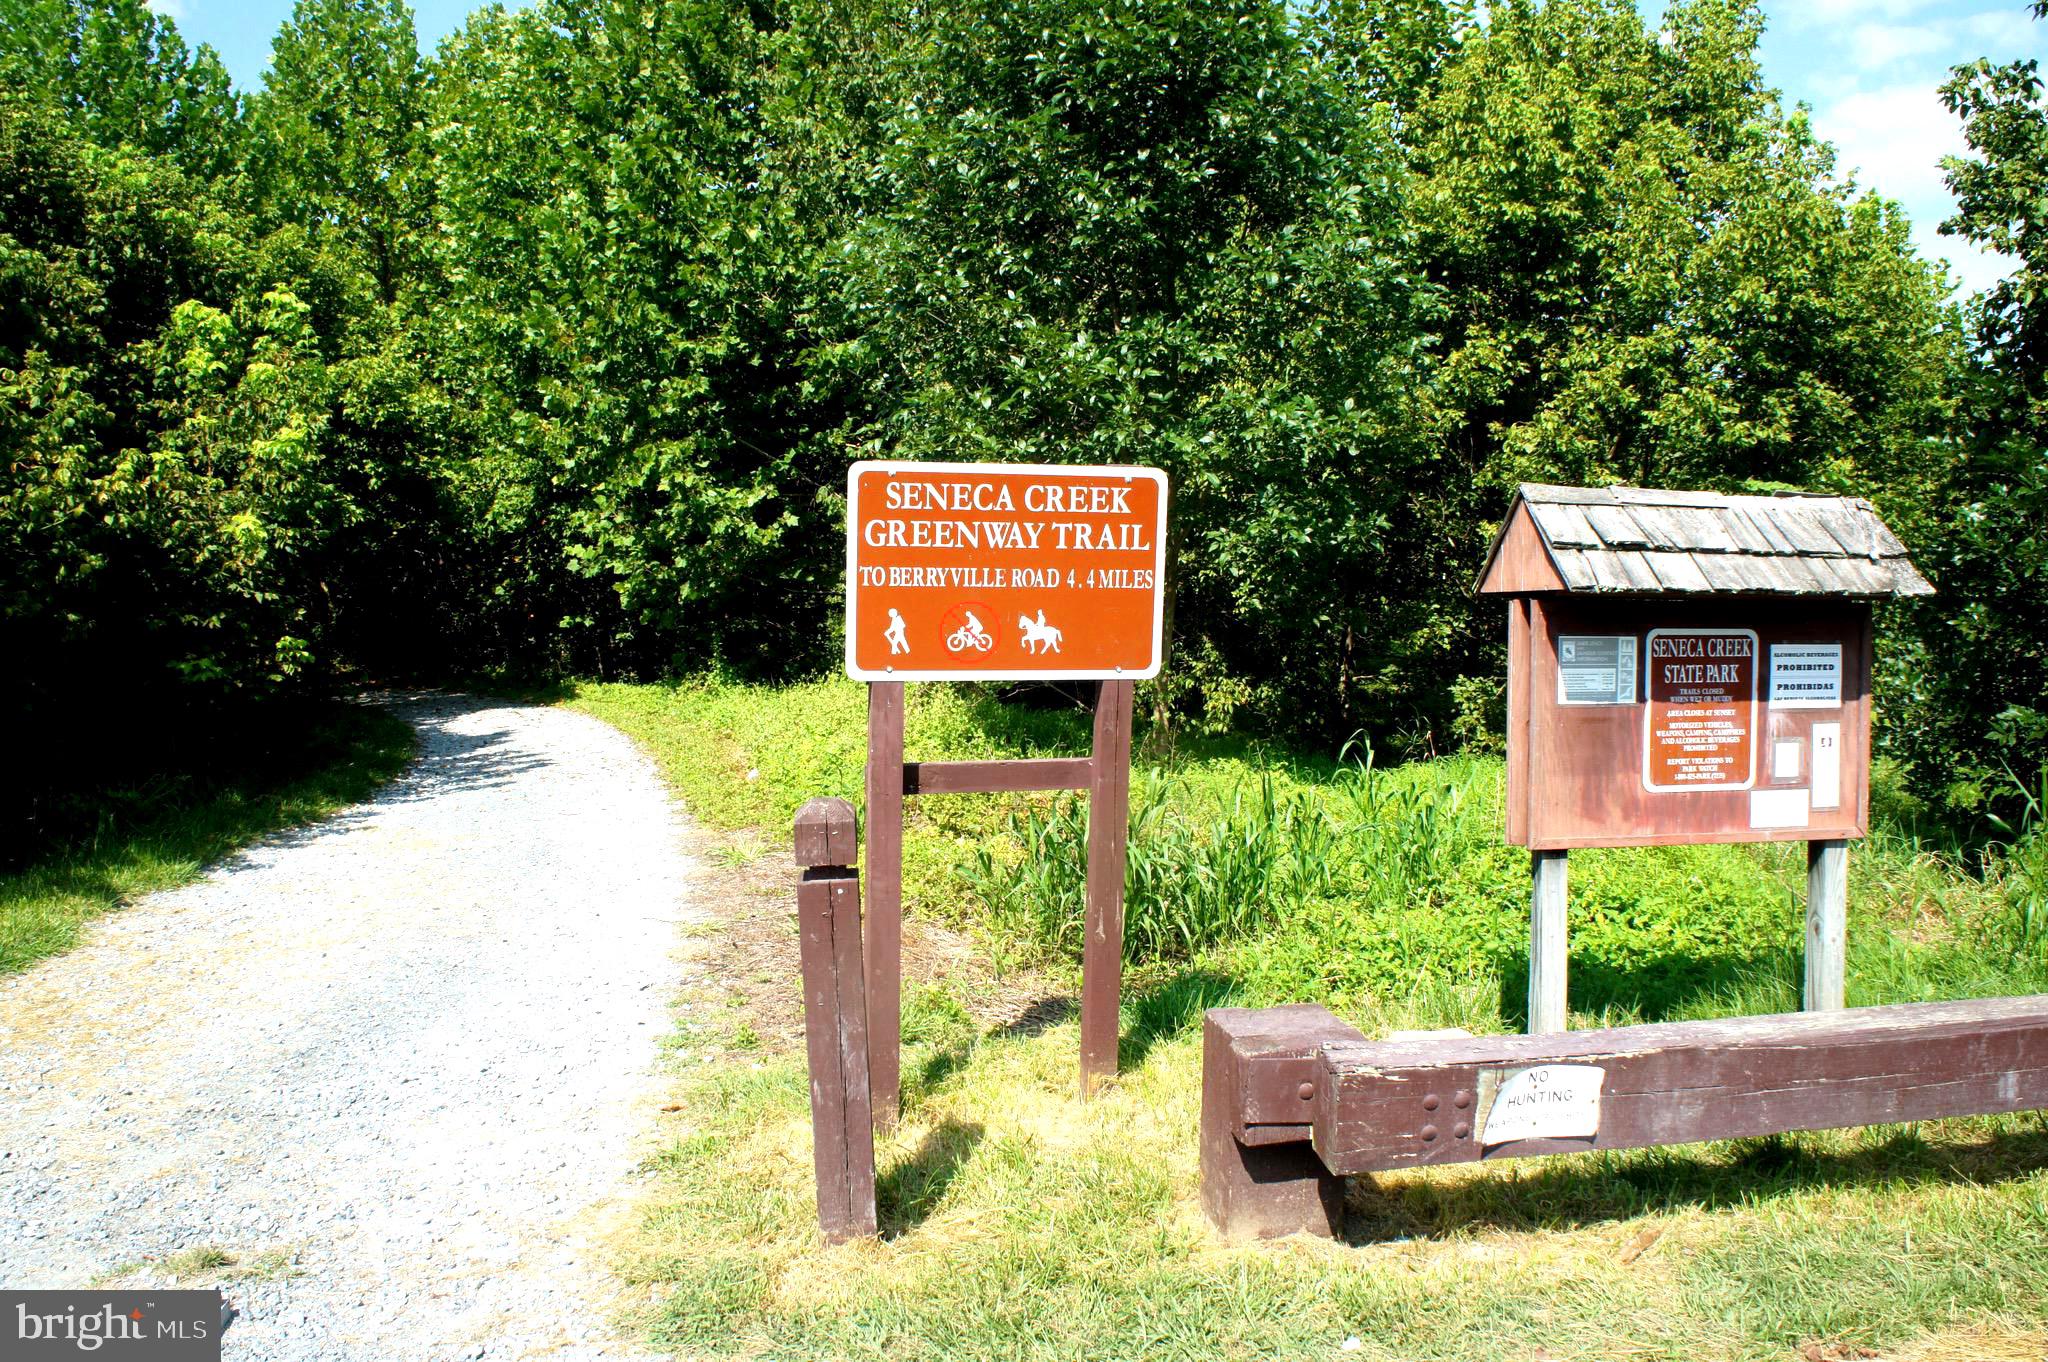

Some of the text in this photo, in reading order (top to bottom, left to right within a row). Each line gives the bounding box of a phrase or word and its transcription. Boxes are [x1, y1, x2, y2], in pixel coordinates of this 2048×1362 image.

[886, 481, 1132, 514] SENECA CREEK
[864, 519, 1150, 551] GREENWAY TRAIL
[859, 565, 886, 587] TO
[888, 566, 1007, 588] BERRYVILLE
[1011, 567, 1060, 588] ROAD
[1098, 569, 1153, 589] MILES
[1653, 638, 1752, 657] SENECA CREEK
[1664, 664, 1740, 683] STATE PARK
[1776, 683, 1834, 691] PROHIBIDAS
[1670, 695, 1689, 703] WHEN
[1684, 709, 1705, 717] CLOSES
[1691, 757, 1724, 765] VIOLATIONS
[1528, 1070, 1549, 1083] NO
[1507, 1089, 1573, 1108] HUNTING
